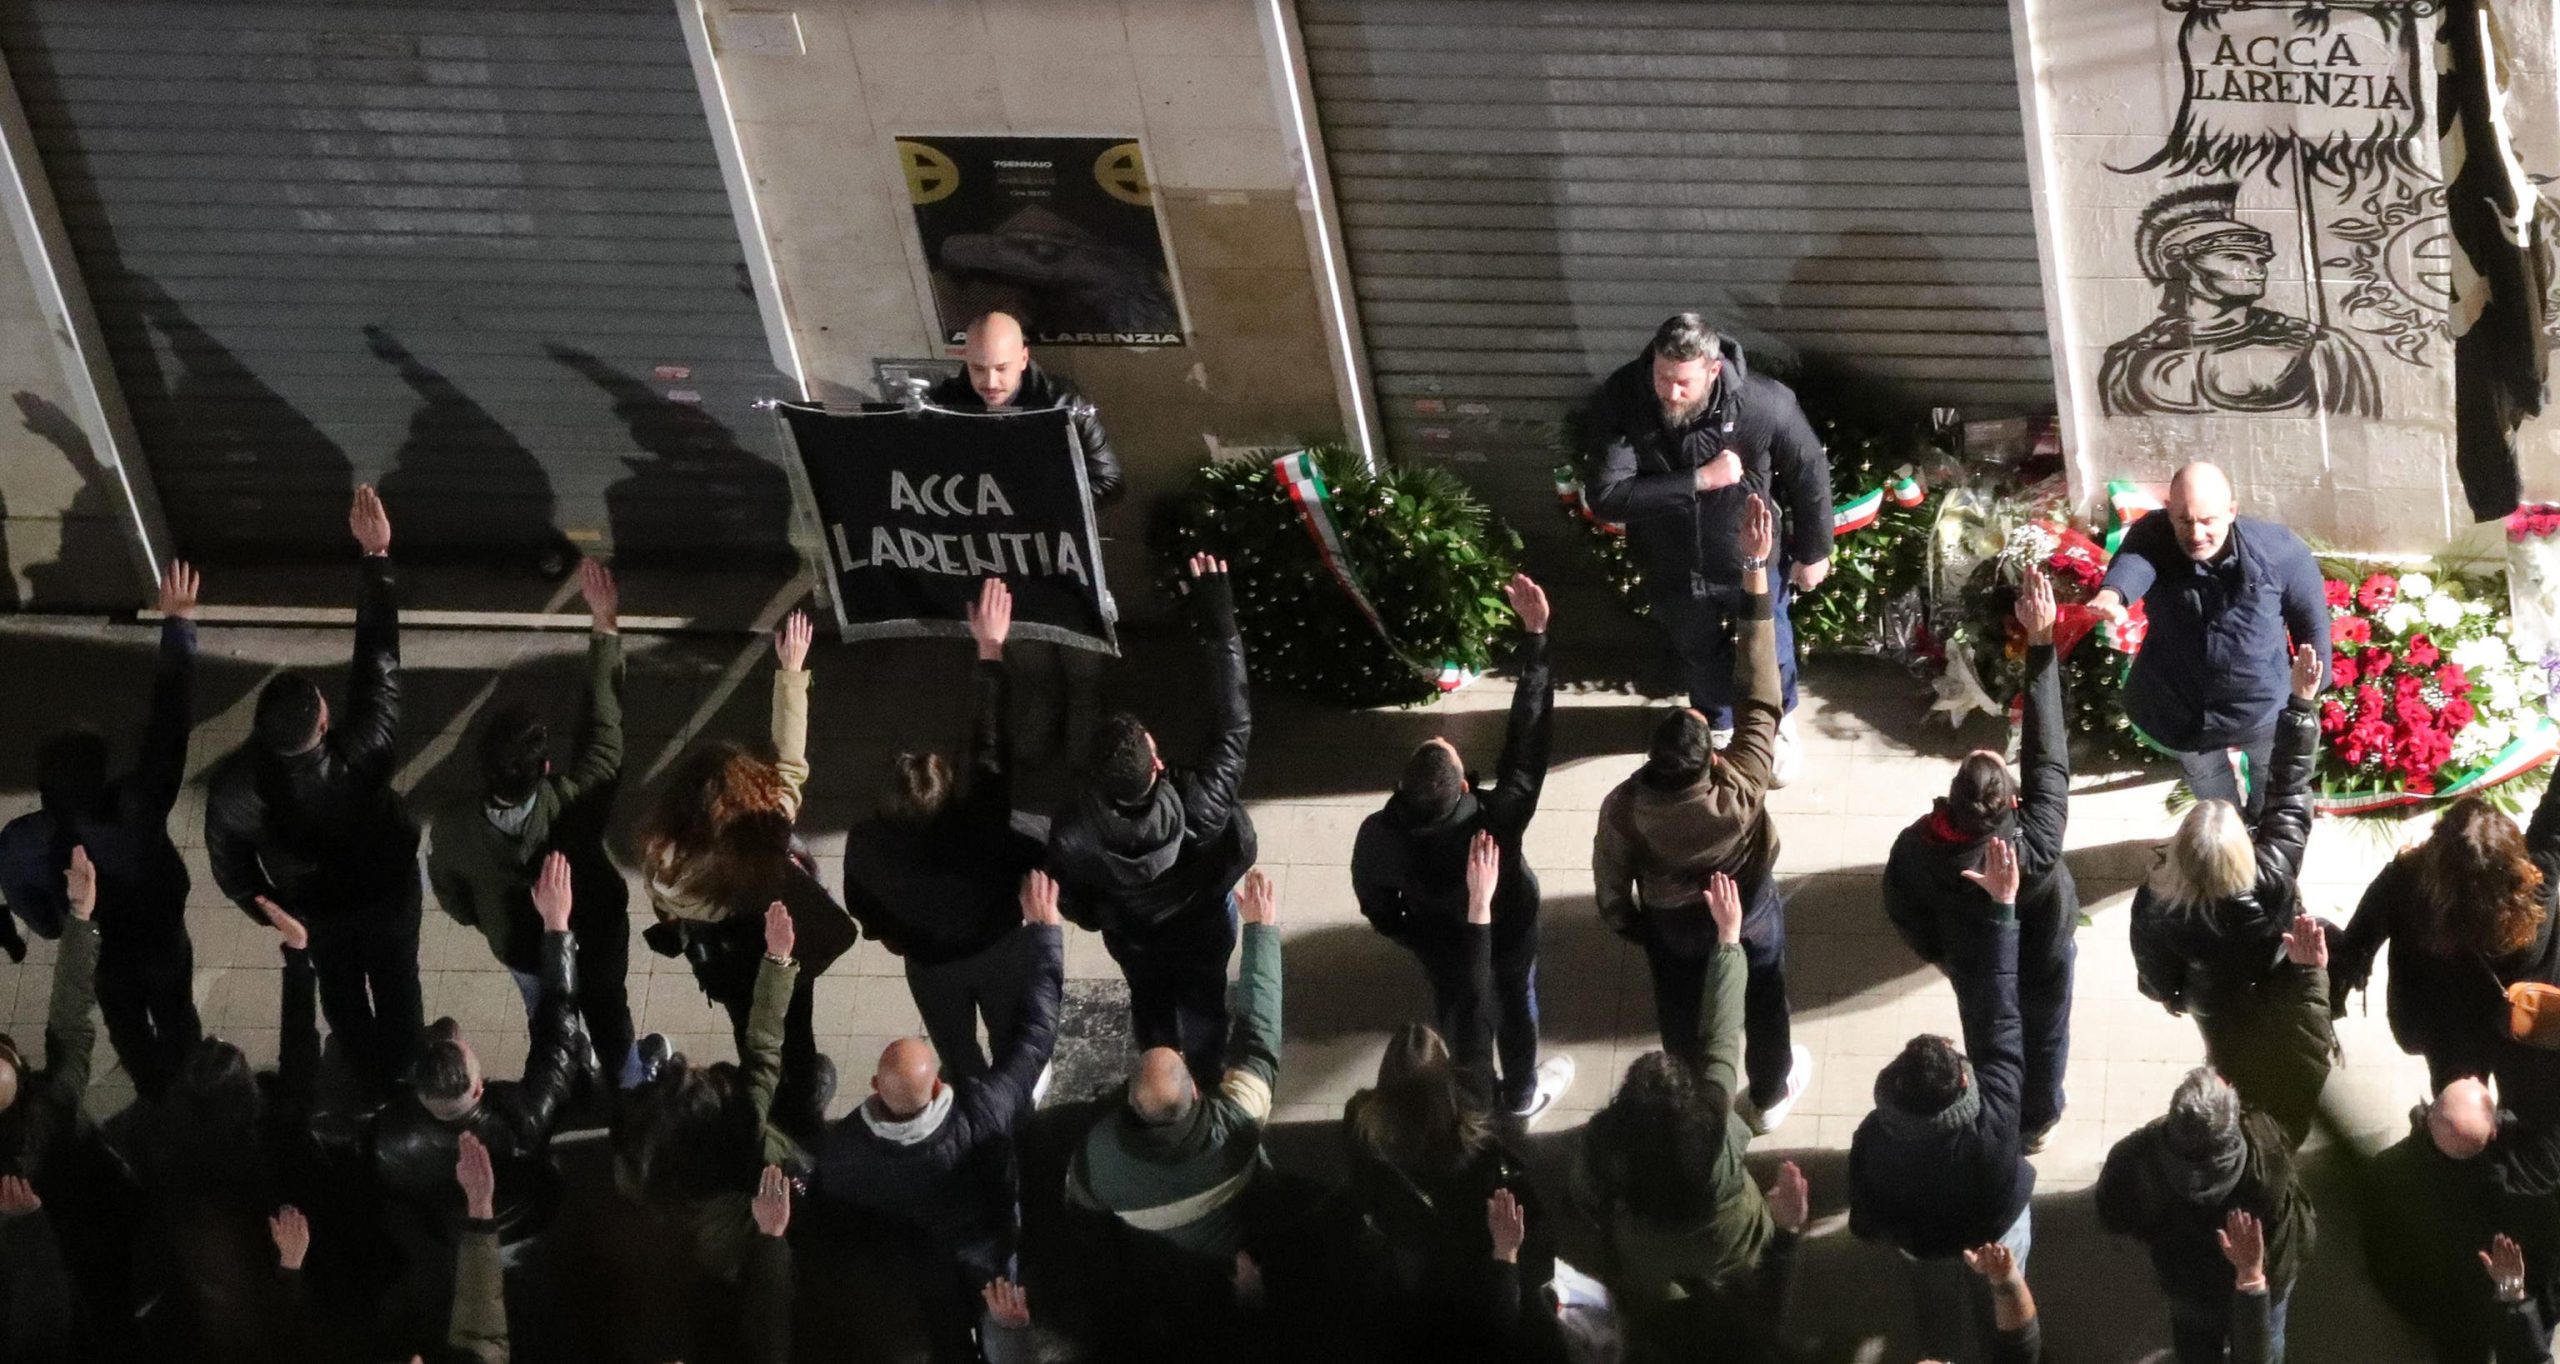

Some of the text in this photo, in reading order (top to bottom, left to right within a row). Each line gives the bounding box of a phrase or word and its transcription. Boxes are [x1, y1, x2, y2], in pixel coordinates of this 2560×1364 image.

[2211, 34, 2360, 68] ACCA
[2191, 69, 2411, 110] LARENZIA
[1040, 331, 1181, 344] LARENZIA
[890, 470, 1014, 517] ACCA
[832, 523, 1090, 586] LARENTIA
